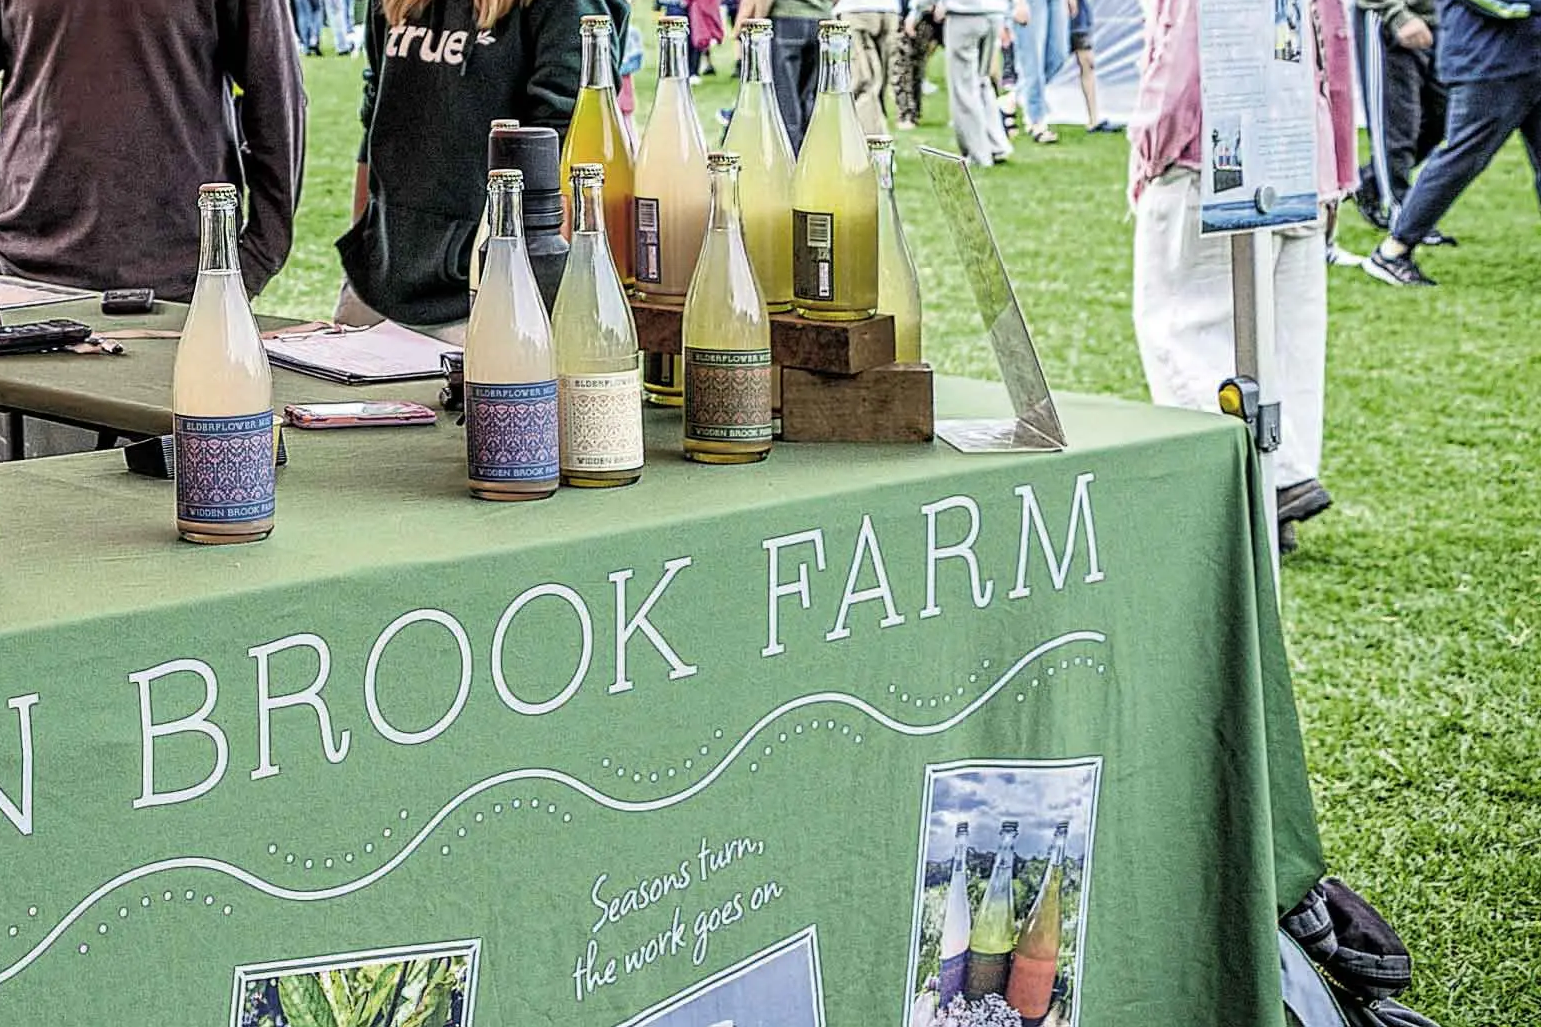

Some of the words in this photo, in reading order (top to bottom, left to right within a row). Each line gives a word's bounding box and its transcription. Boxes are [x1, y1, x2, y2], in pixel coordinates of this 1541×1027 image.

[385, 19, 469, 65] true
[186, 420, 256, 431] ELDERFLOWER
[189, 507, 225, 518] WIDDEN
[227, 507, 259, 517] BROOK
[129, 556, 698, 809] BROOK
[760, 472, 1106, 658] FARM
[591, 860, 691, 933] Seasons
[697, 836, 765, 881] turn,
[572, 939, 617, 1002] the
[624, 906, 687, 975] work
[692, 894, 744, 966] goes
[750, 880, 784, 911] on
